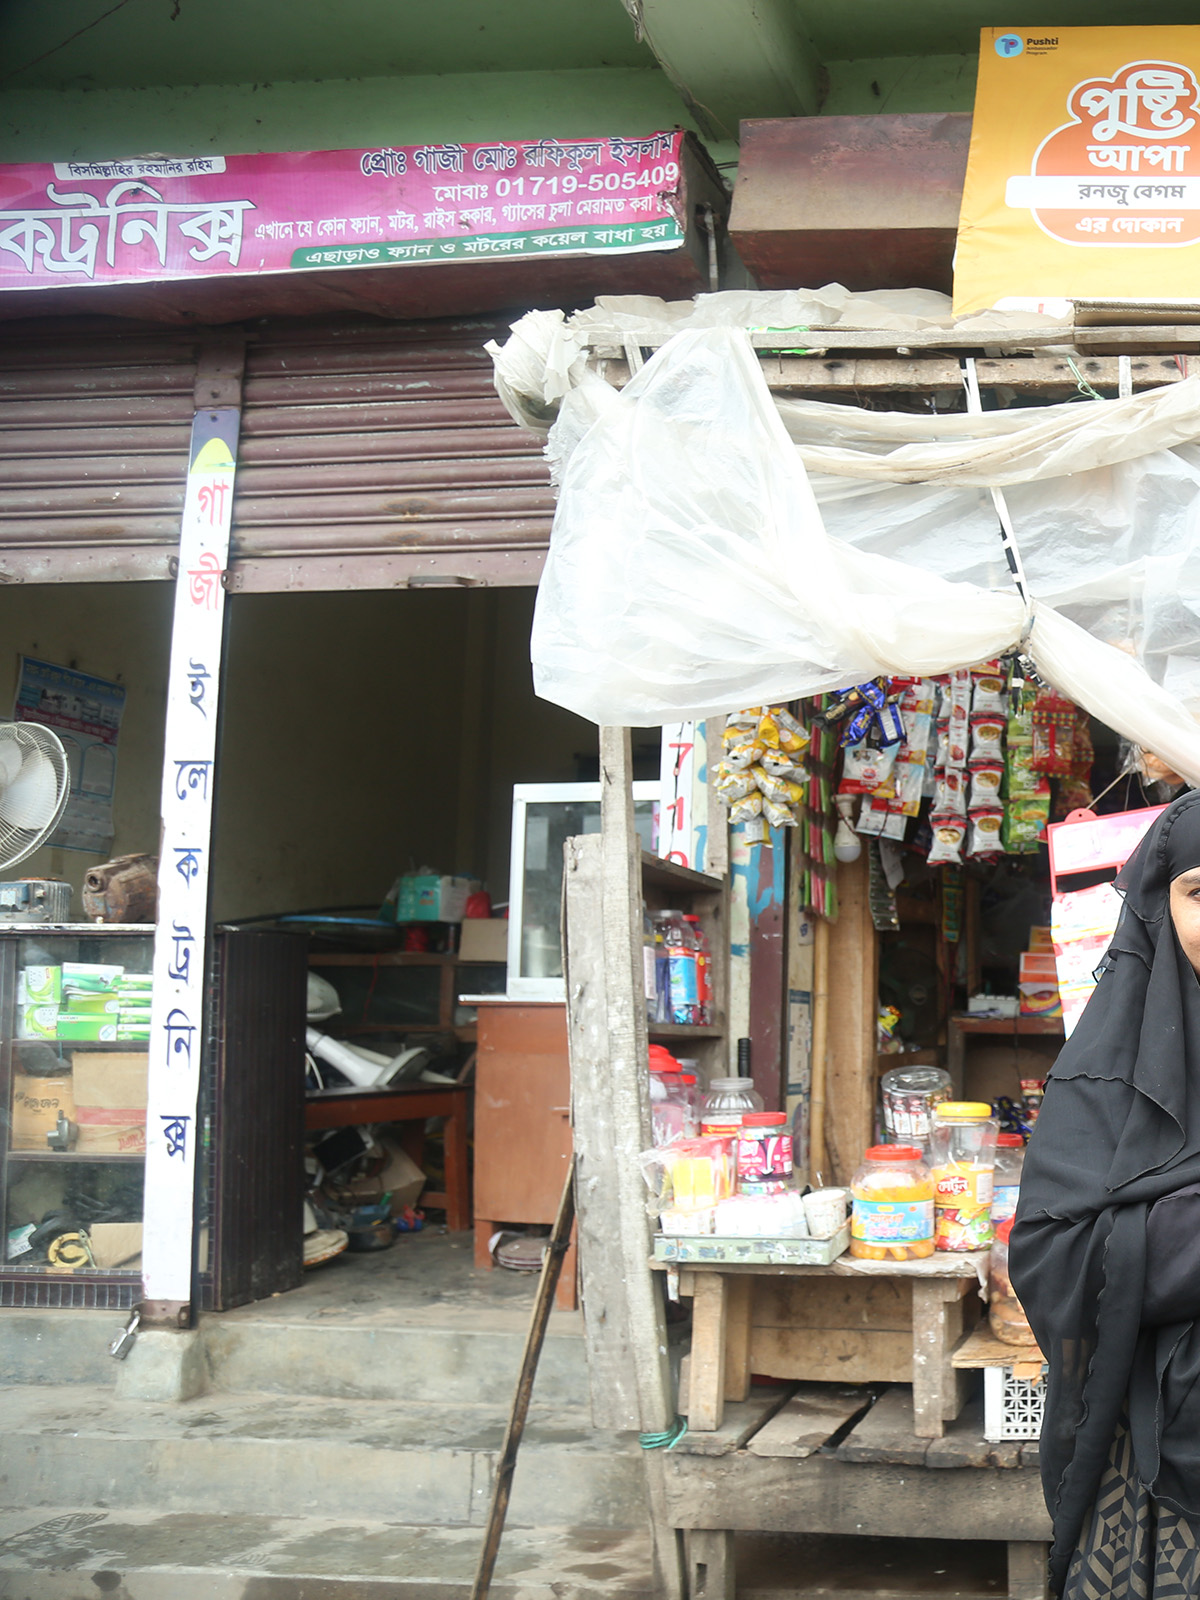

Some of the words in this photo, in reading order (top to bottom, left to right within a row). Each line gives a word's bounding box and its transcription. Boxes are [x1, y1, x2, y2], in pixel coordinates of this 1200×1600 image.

[1026, 37, 1059, 45] Pushti
[1080, 69, 1196, 141] পুষ্টি
[68, 161, 134, 178] বিসমিল্লাহির
[138, 160, 183, 176] রহমানির
[186, 157, 214, 172] রহিম
[360, 148, 407, 178] প্রোঃ
[413, 143, 468, 174] গাজী
[473, 143, 517, 171] মোঃ
[522, 138, 604, 173] রফিকুল
[1086, 145, 1191, 171] আপা
[433, 184, 489, 201] মোবাঃ
[495, 161, 679, 197] 01719-505409
[1078, 184, 1129, 206] রনজু
[1133, 185, 1187, 199] বেগম
[255, 221, 293, 239] এখানে
[296, 220, 313, 237] যে
[317, 217, 347, 236] কোন
[423, 206, 456, 228] রাইস
[502, 203, 548, 222] গ্যাসের
[548, 200, 573, 222] চুলা
[577, 198, 627, 215] মেরামত
[630, 194, 653, 212] করা
[1075, 217, 1110, 234] এর
[1112, 217, 1184, 233] দোকান
[305, 247, 380, 263] এছাড়াও
[387, 244, 433, 257] ফ্যান
[439, 244, 456, 255] ও
[463, 236, 527, 252] মটরের
[532, 231, 588, 246] কয়েল
[640, 223, 669, 239] হয়
